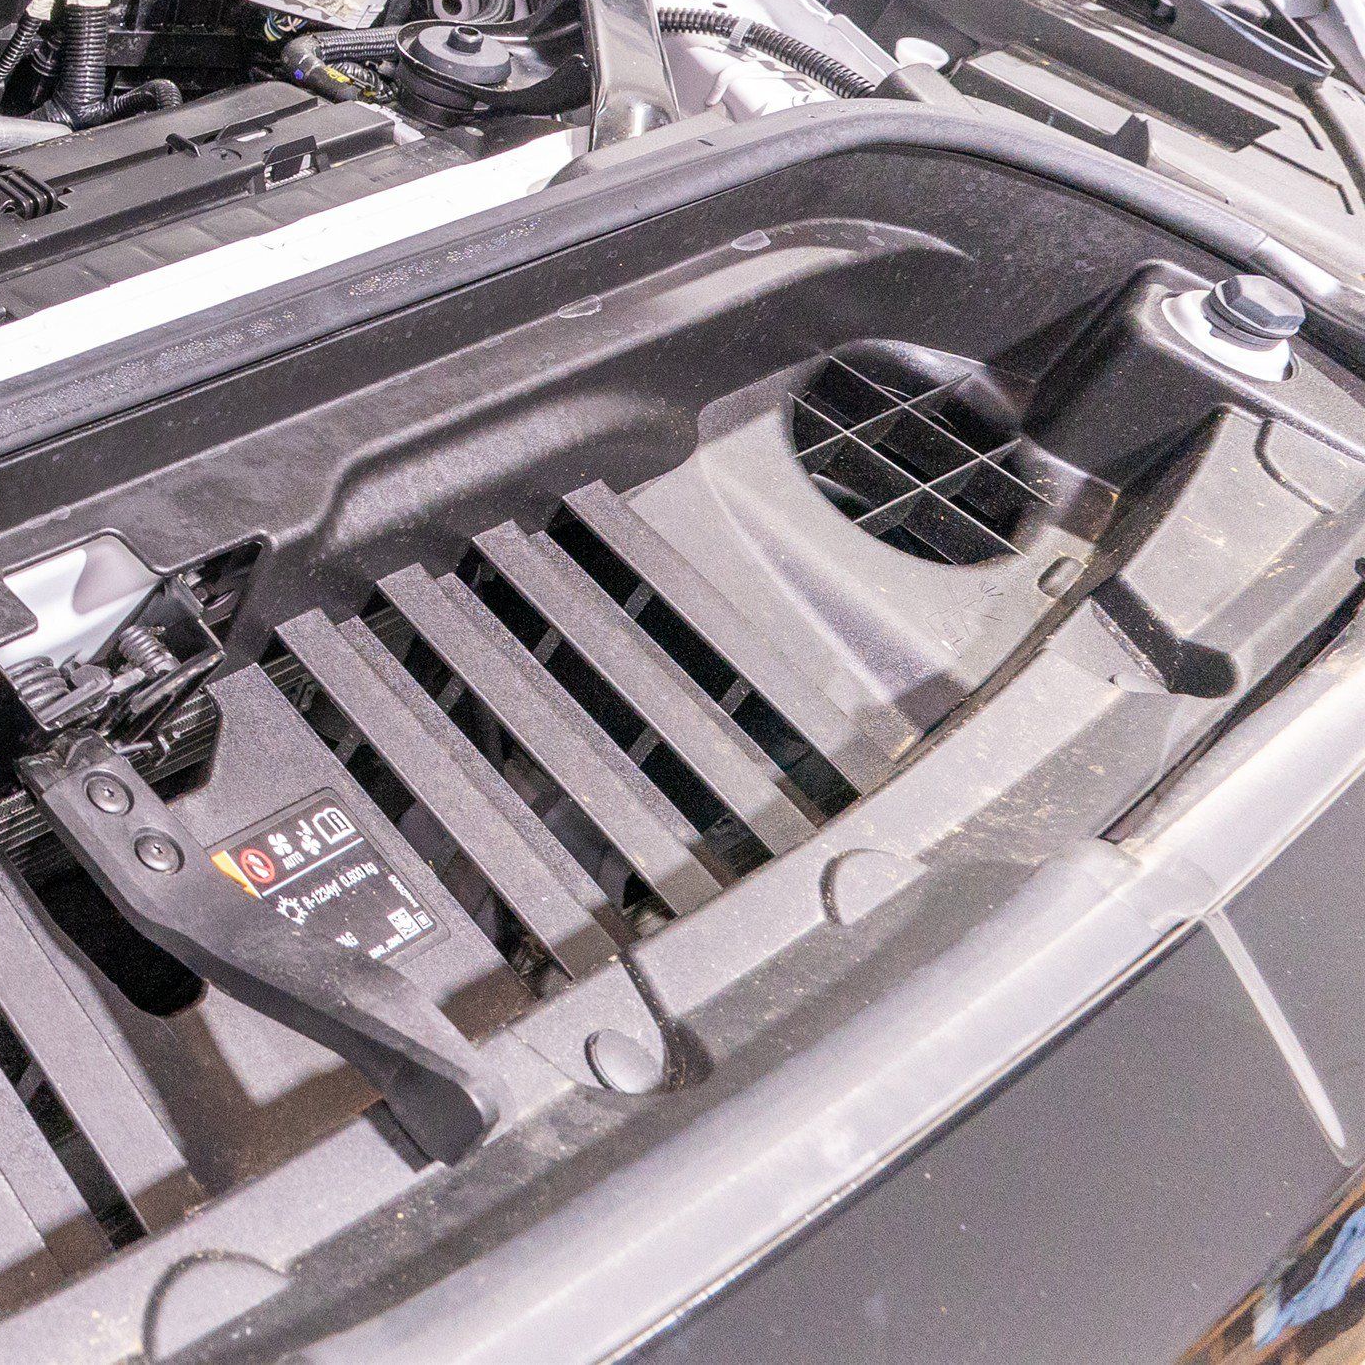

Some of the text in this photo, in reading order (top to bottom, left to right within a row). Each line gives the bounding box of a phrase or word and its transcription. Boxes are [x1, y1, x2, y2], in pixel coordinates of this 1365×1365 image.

[282, 851, 305, 870] AUTO
[301, 879, 343, 910] R-1234yf
[360, 861, 379, 876] kg
